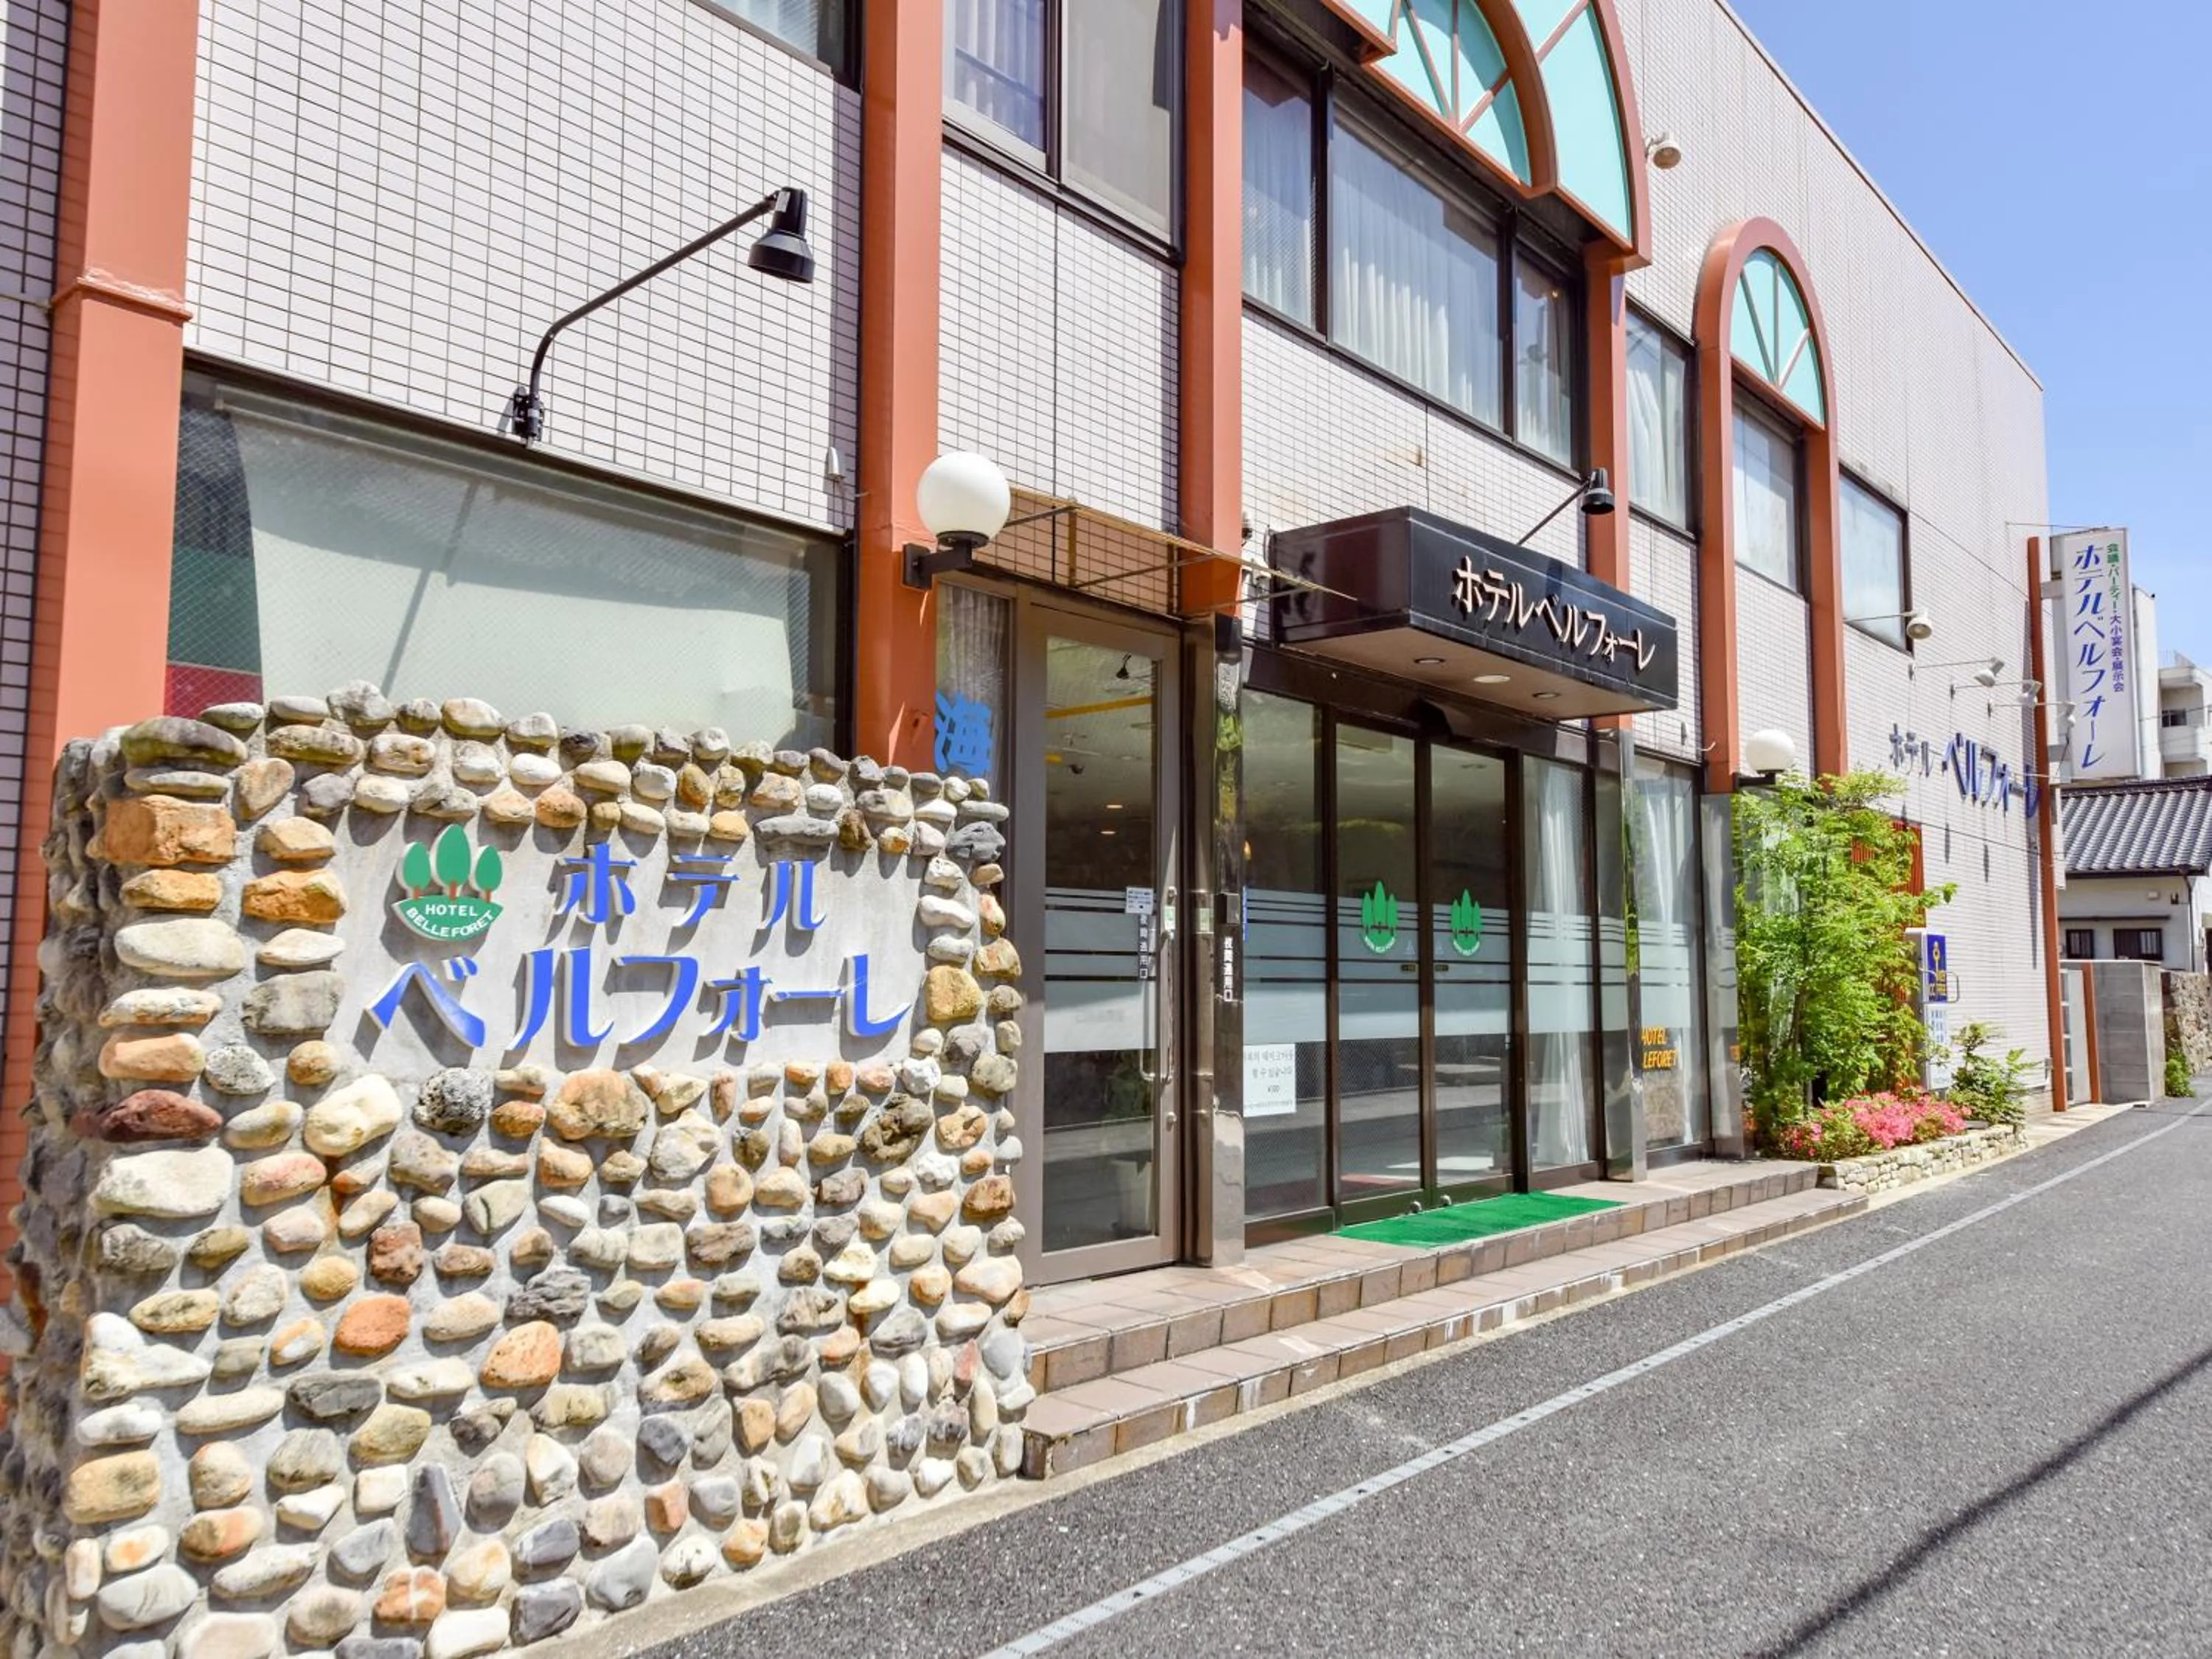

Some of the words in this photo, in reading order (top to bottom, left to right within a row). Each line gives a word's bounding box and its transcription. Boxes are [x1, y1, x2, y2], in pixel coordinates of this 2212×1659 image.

[1453, 554, 1656, 671] ホテルベルフォーレ
[2073, 544, 2107, 769] ホテルベルフォーレ
[425, 904, 478, 917] HOTEL
[553, 842, 826, 931] ホテル
[364, 945, 911, 1050] ベルフォーレ
